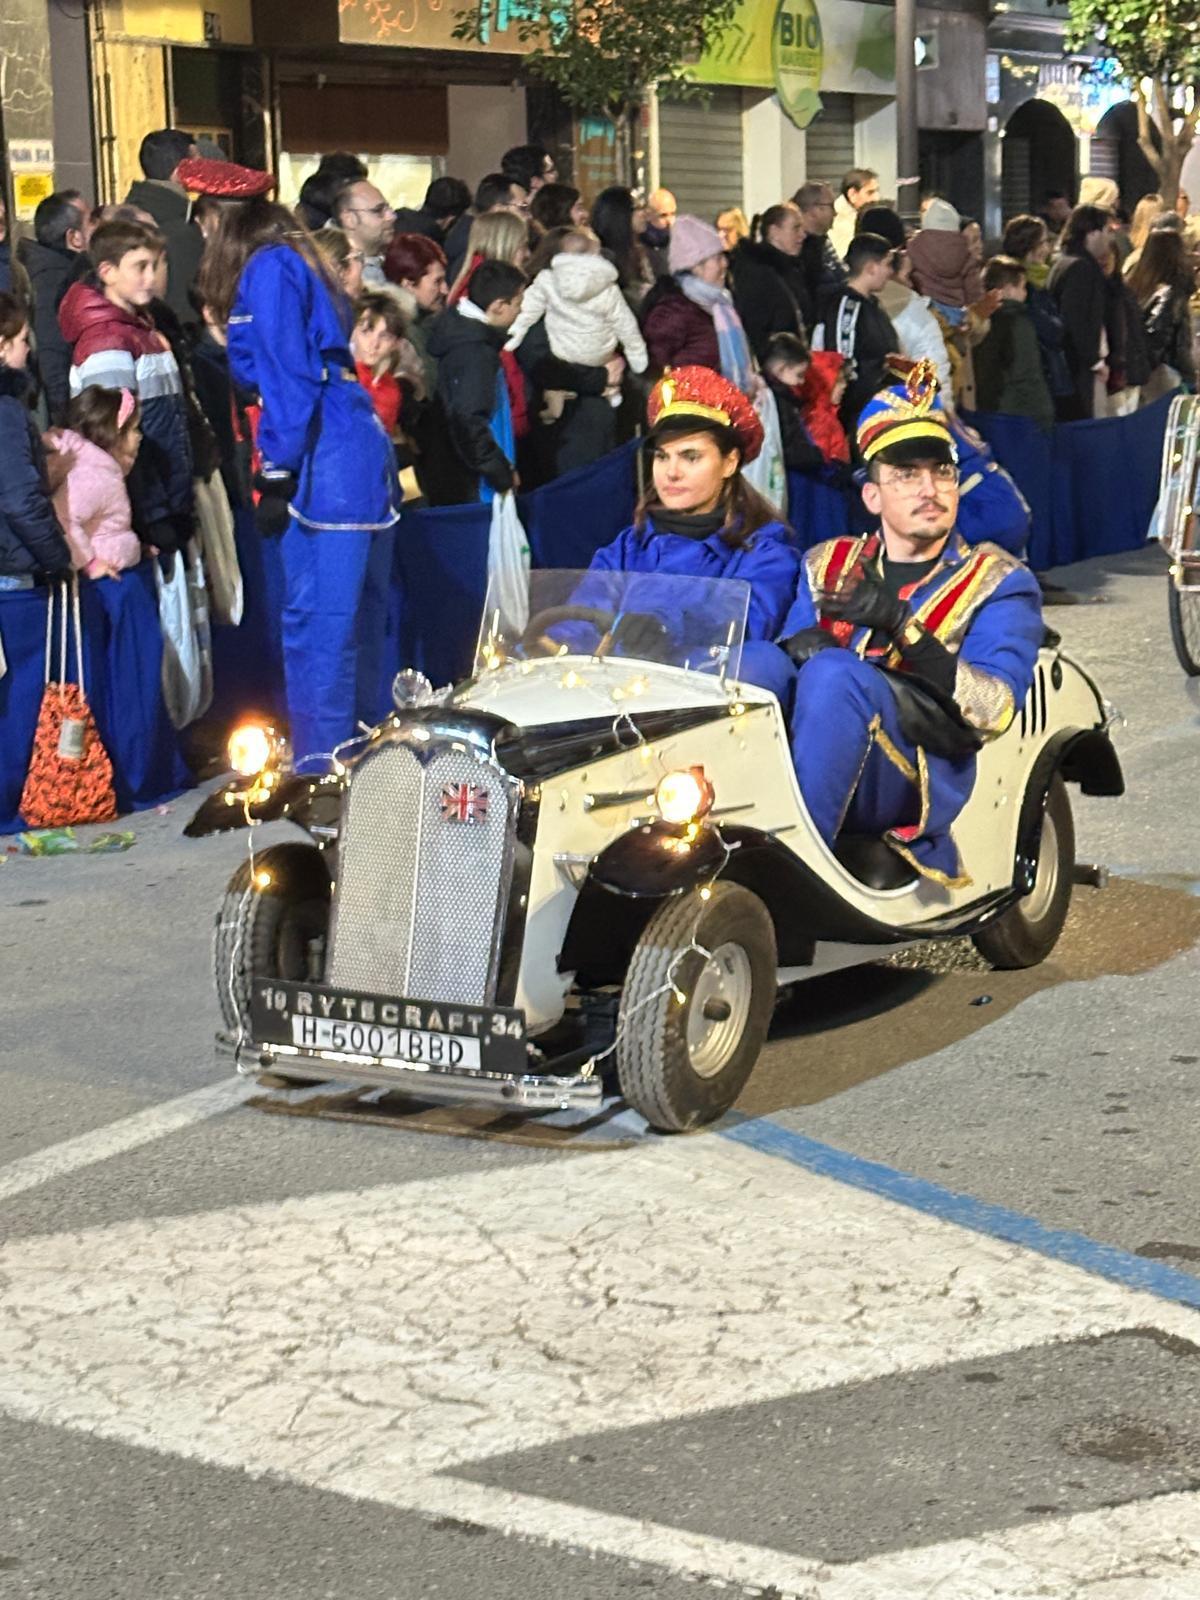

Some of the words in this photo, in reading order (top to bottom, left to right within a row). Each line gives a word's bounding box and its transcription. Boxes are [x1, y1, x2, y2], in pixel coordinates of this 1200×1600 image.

[780, 12, 819, 49] BIO
[297, 991, 483, 1035] RYTECRAFT
[491, 1013, 523, 1040] 34
